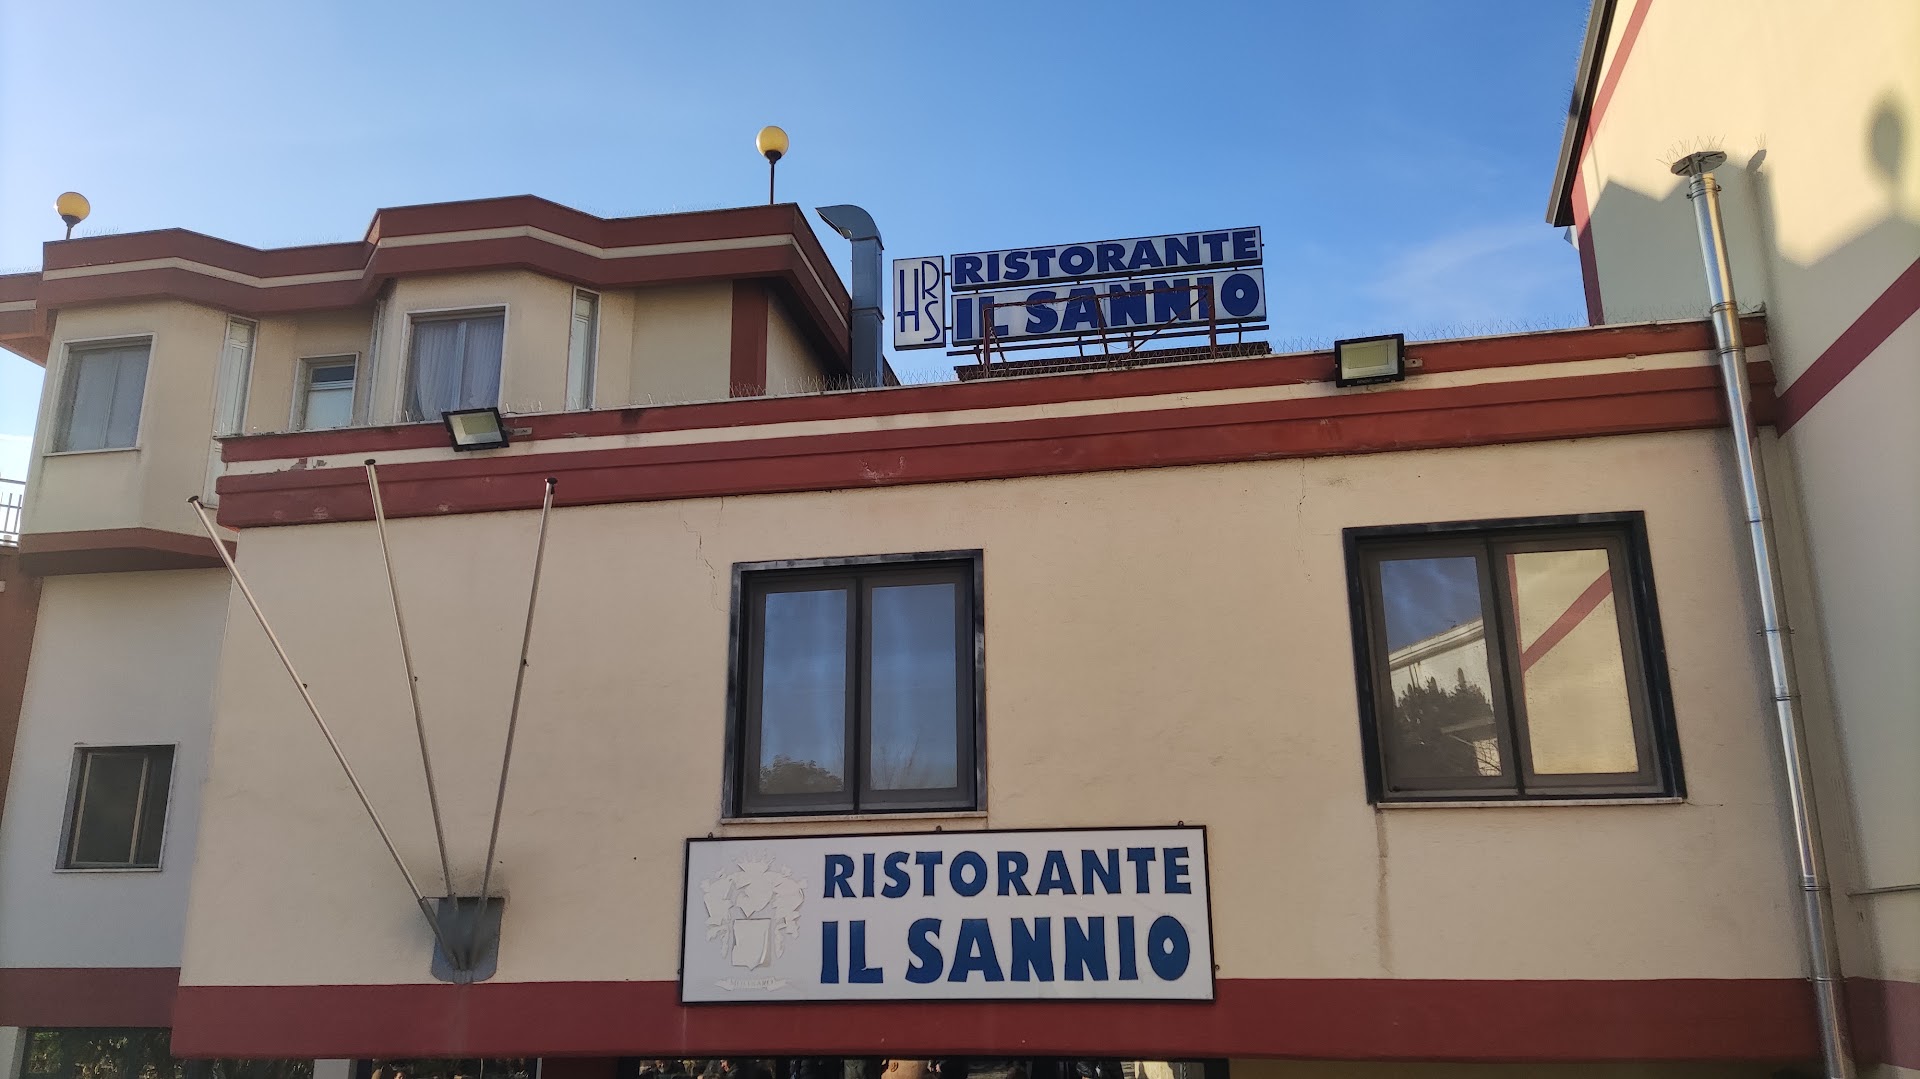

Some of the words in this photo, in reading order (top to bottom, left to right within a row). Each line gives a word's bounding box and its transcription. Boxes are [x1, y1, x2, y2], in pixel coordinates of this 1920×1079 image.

[955, 230, 1258, 285] RISTORANTE
[956, 296, 1009, 340] IL
[1025, 273, 1260, 334] SANNIO
[823, 847, 1192, 898] RISTORANTE
[820, 920, 884, 984] IL
[904, 915, 1190, 984] SANNIO
